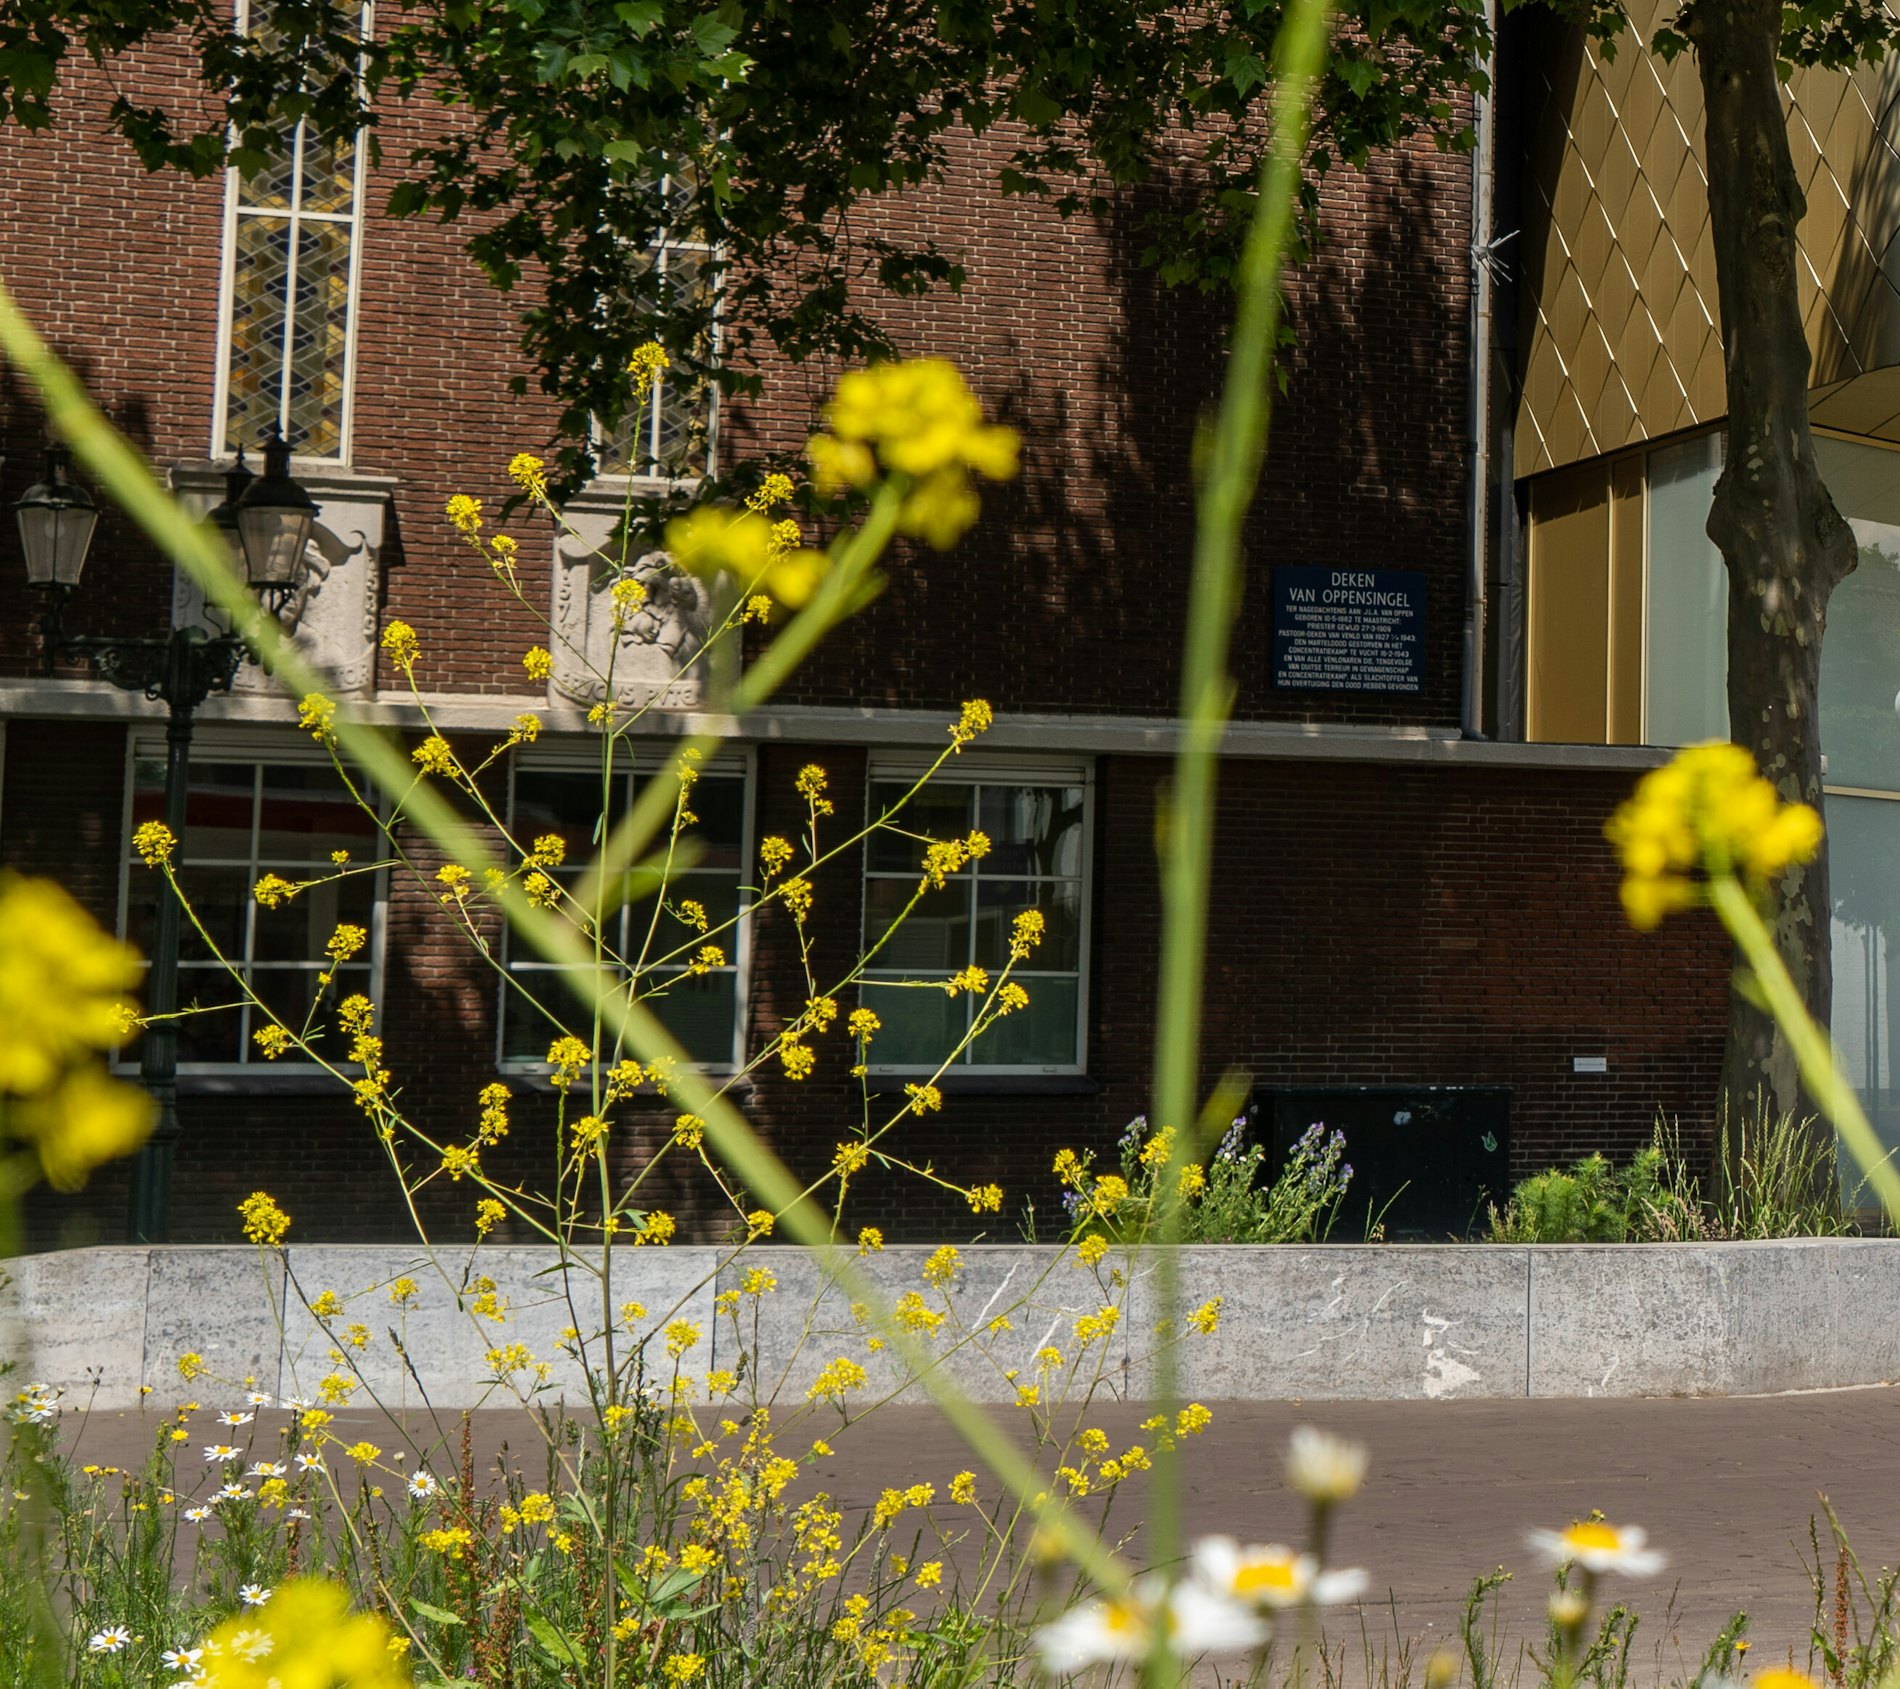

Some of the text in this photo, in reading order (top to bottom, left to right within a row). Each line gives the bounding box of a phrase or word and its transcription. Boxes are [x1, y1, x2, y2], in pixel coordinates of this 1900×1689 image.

[1331, 573, 1375, 587] DEKEN
[1289, 588, 1410, 607] VAN OPPENSINGEL
[1298, 605, 1347, 614] NAGEDACHTENIS
[1393, 609, 1414, 617] OPPEN
[1294, 614, 1323, 622] GEBOREN
[1306, 622, 1336, 630] PRIESTER
[1328, 631, 1340, 639] VAN
[1341, 632, 1361, 640] VENLO
[1375, 633, 1390, 641] 1927
[1294, 638, 1307, 646] DEN
[1348, 640, 1383, 649] GESTORVEN
[1358, 649, 1379, 657] VUCHT
[1283, 654, 1293, 662] EN
[1307, 655, 1322, 663] ALLE
[1323, 664, 1351, 672] TERREUR
[1363, 674, 1405, 683] SLACHTOFFER
[1277, 679, 1291, 687] HUN
[1331, 681, 1344, 689] DEN
[1387, 683, 1419, 692] GEVONDEN
